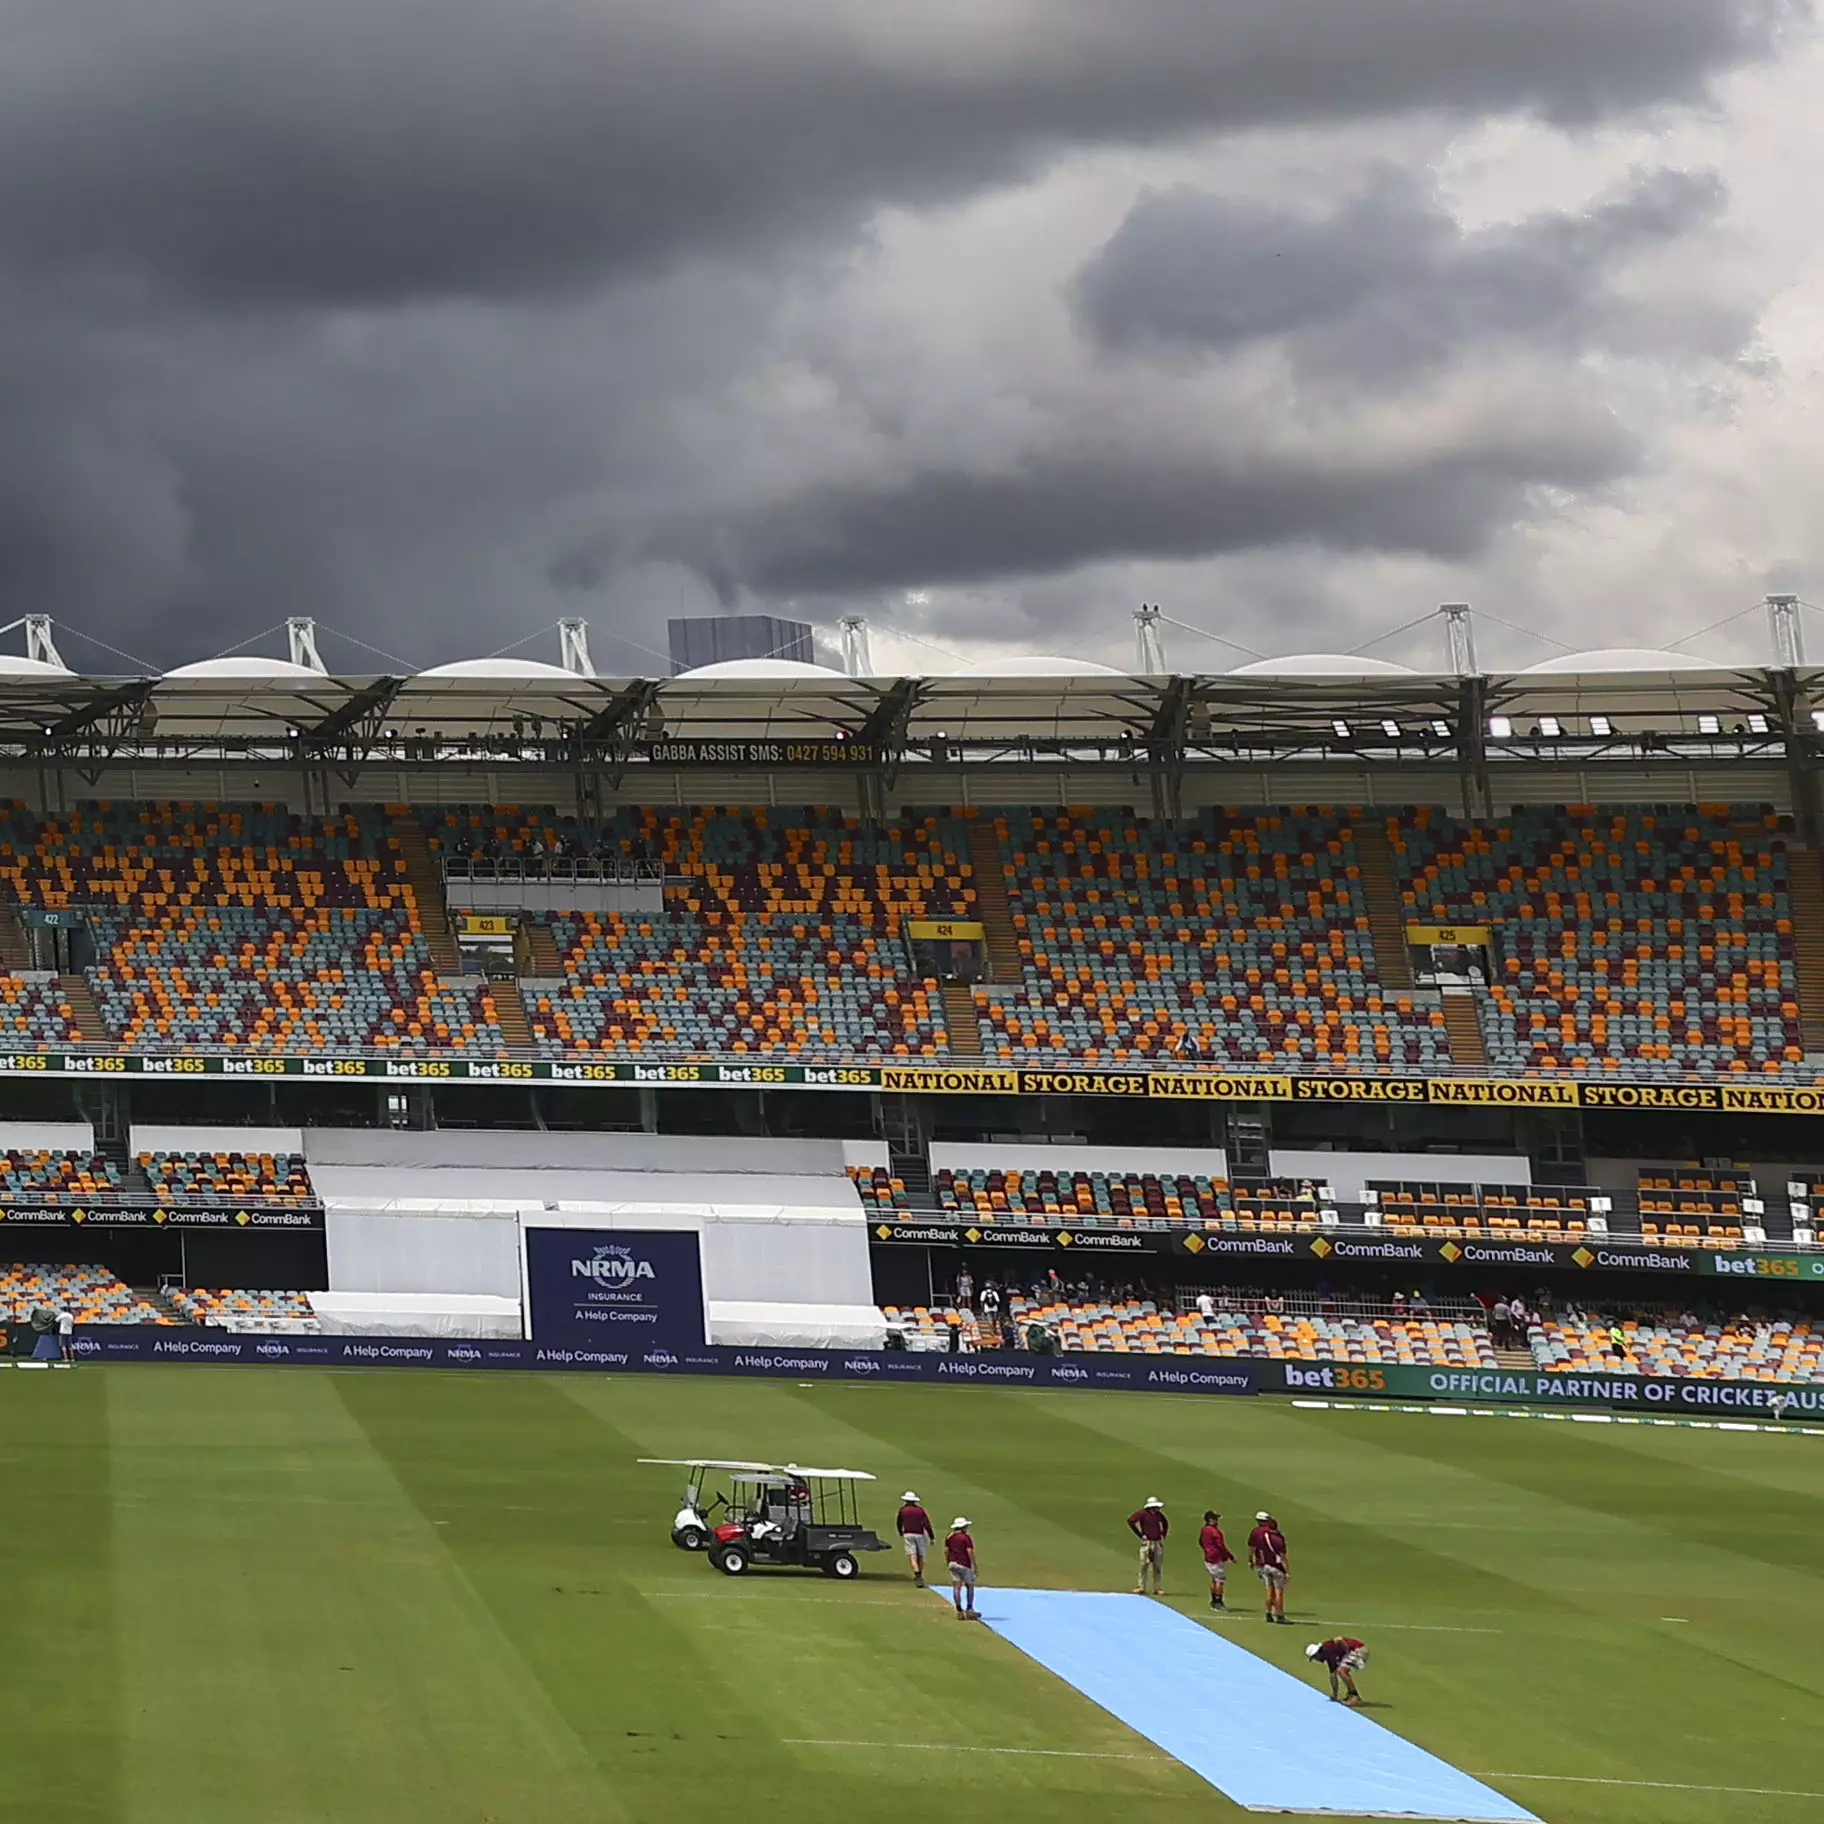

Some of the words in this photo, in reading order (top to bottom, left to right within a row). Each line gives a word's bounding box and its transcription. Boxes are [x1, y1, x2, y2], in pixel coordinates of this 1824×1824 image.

[652, 745, 696, 762] GABBA
[700, 745, 744, 762] ASSIST
[748, 745, 783, 762] SMS:
[787, 745, 820, 762] 0427
[823, 745, 847, 762] 594
[851, 745, 873, 762] 931
[44, 914, 60, 924] 422
[223, 1058, 286, 1074] bet365
[468, 1062, 533, 1077] bet365
[718, 1066, 784, 1083] bet365
[885, 1071, 1014, 1093] NATIONAL
[1024, 1074, 1143, 1094] STORAGE
[1152, 1076, 1287, 1097] NATIONAL
[1298, 1079, 1423, 1100] STORAGE
[1431, 1083, 1573, 1104] NATIONAL
[1584, 1086, 1717, 1108] STORAGE
[88, 1209, 147, 1223] CommBank
[251, 1212, 311, 1225] CommBank
[983, 1229, 1050, 1244] CommBank
[1207, 1237, 1293, 1254] CommBank
[1465, 1246, 1554, 1264] CommBank
[572, 1259, 655, 1278] NRMA
[1715, 1256, 1799, 1276] bet365
[588, 1293, 642, 1301] INSURANCE
[575, 1310, 584, 1319] A
[585, 1310, 608, 1321] Help
[610, 1311, 657, 1323] Company
[165, 1340, 189, 1355] Help
[191, 1341, 241, 1358] Company
[447, 1347, 482, 1361] NRMA
[1052, 1368, 1088, 1380] NRMA
[1286, 1364, 1386, 1390] bet365
